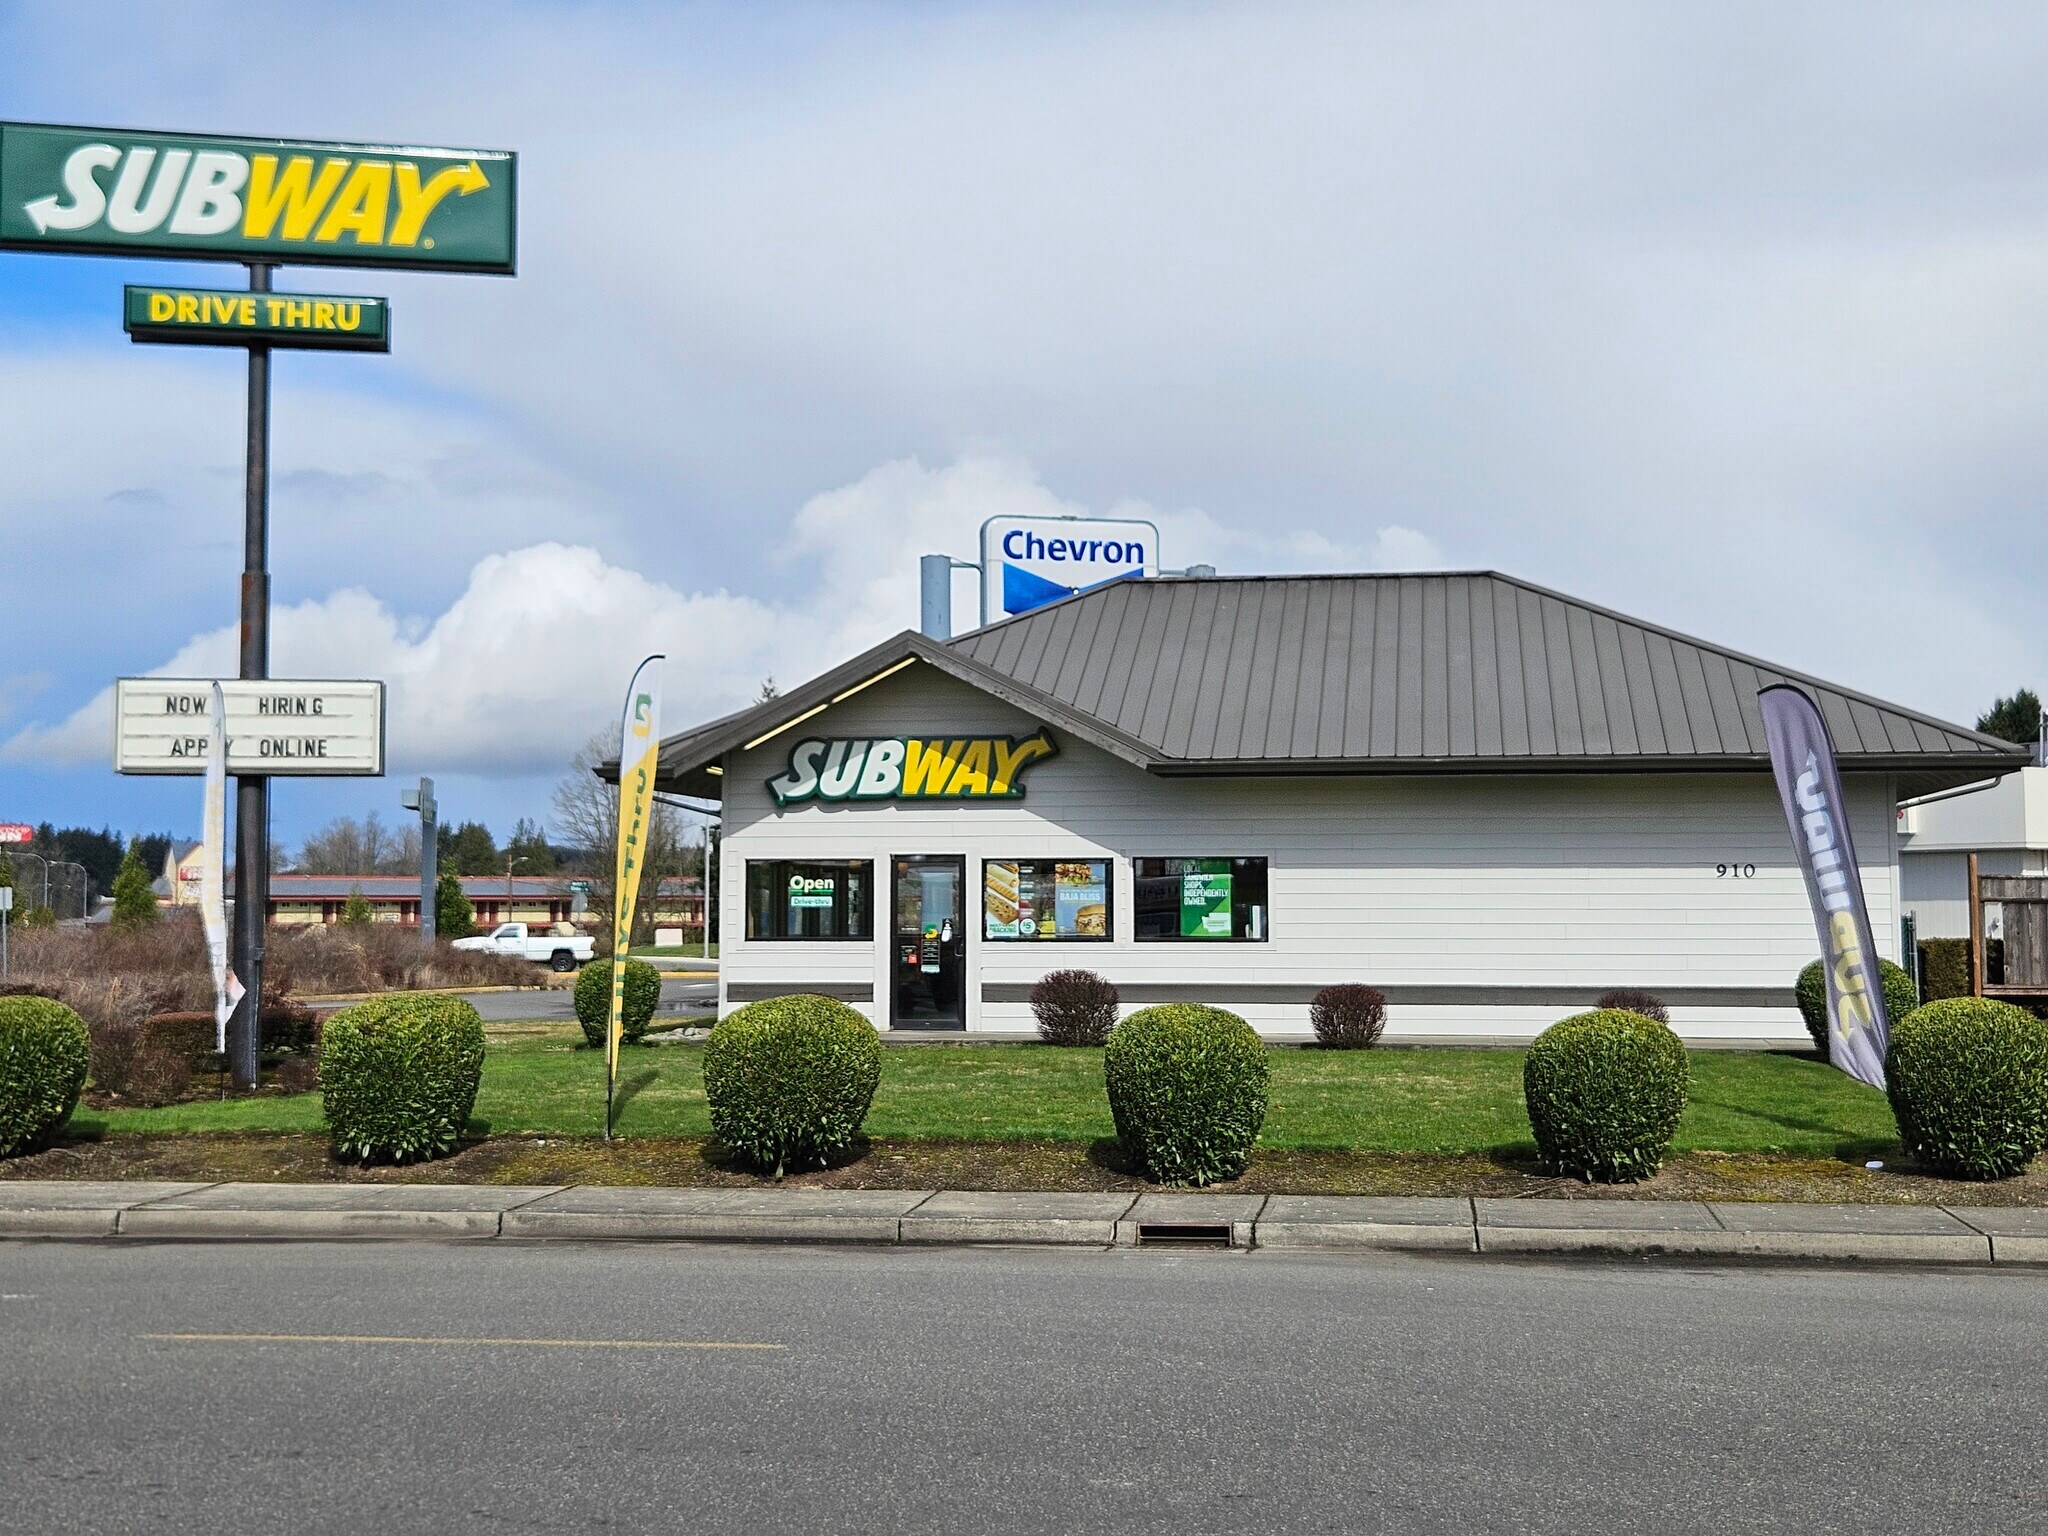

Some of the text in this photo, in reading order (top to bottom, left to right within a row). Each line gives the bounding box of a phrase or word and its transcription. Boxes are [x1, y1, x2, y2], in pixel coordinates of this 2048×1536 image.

[24, 143, 490, 248] SUBWAY
[150, 293, 361, 332] DRIVE THRU
[1003, 530, 1143, 564] Chevron
[166, 696, 323, 715] NOW HIRING
[170, 738, 327, 758] APPY ONLINE
[771, 735, 1052, 799] SUBWAY
[1716, 863, 1755, 878] 910
[790, 875, 834, 894] Open
[1184, 889, 1229, 897] INDEPENDENTLY
[1060, 892, 1101, 901] BAJA BLISS
